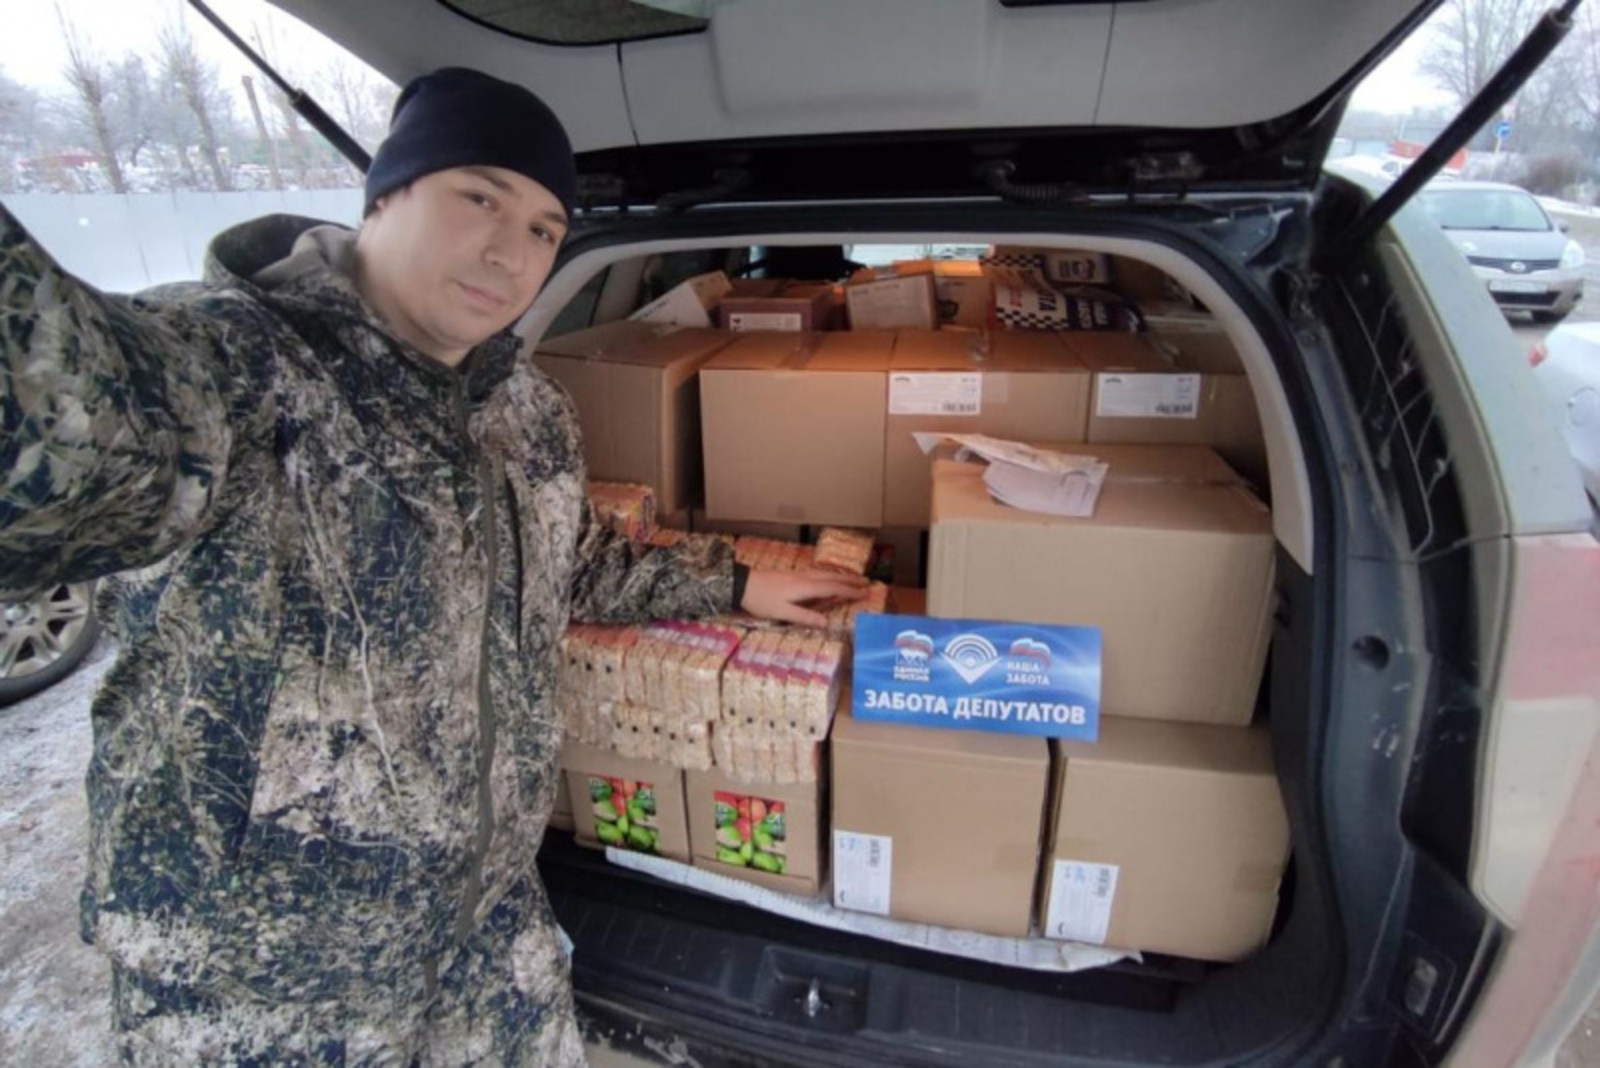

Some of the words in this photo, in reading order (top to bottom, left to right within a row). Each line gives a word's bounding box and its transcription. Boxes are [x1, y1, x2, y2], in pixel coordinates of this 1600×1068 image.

[1006, 672, 1050, 686] ЗАБОТА
[864, 689, 949, 715] ЗАБОТА
[953, 697, 1086, 726] ДЕПУТАТОВ
